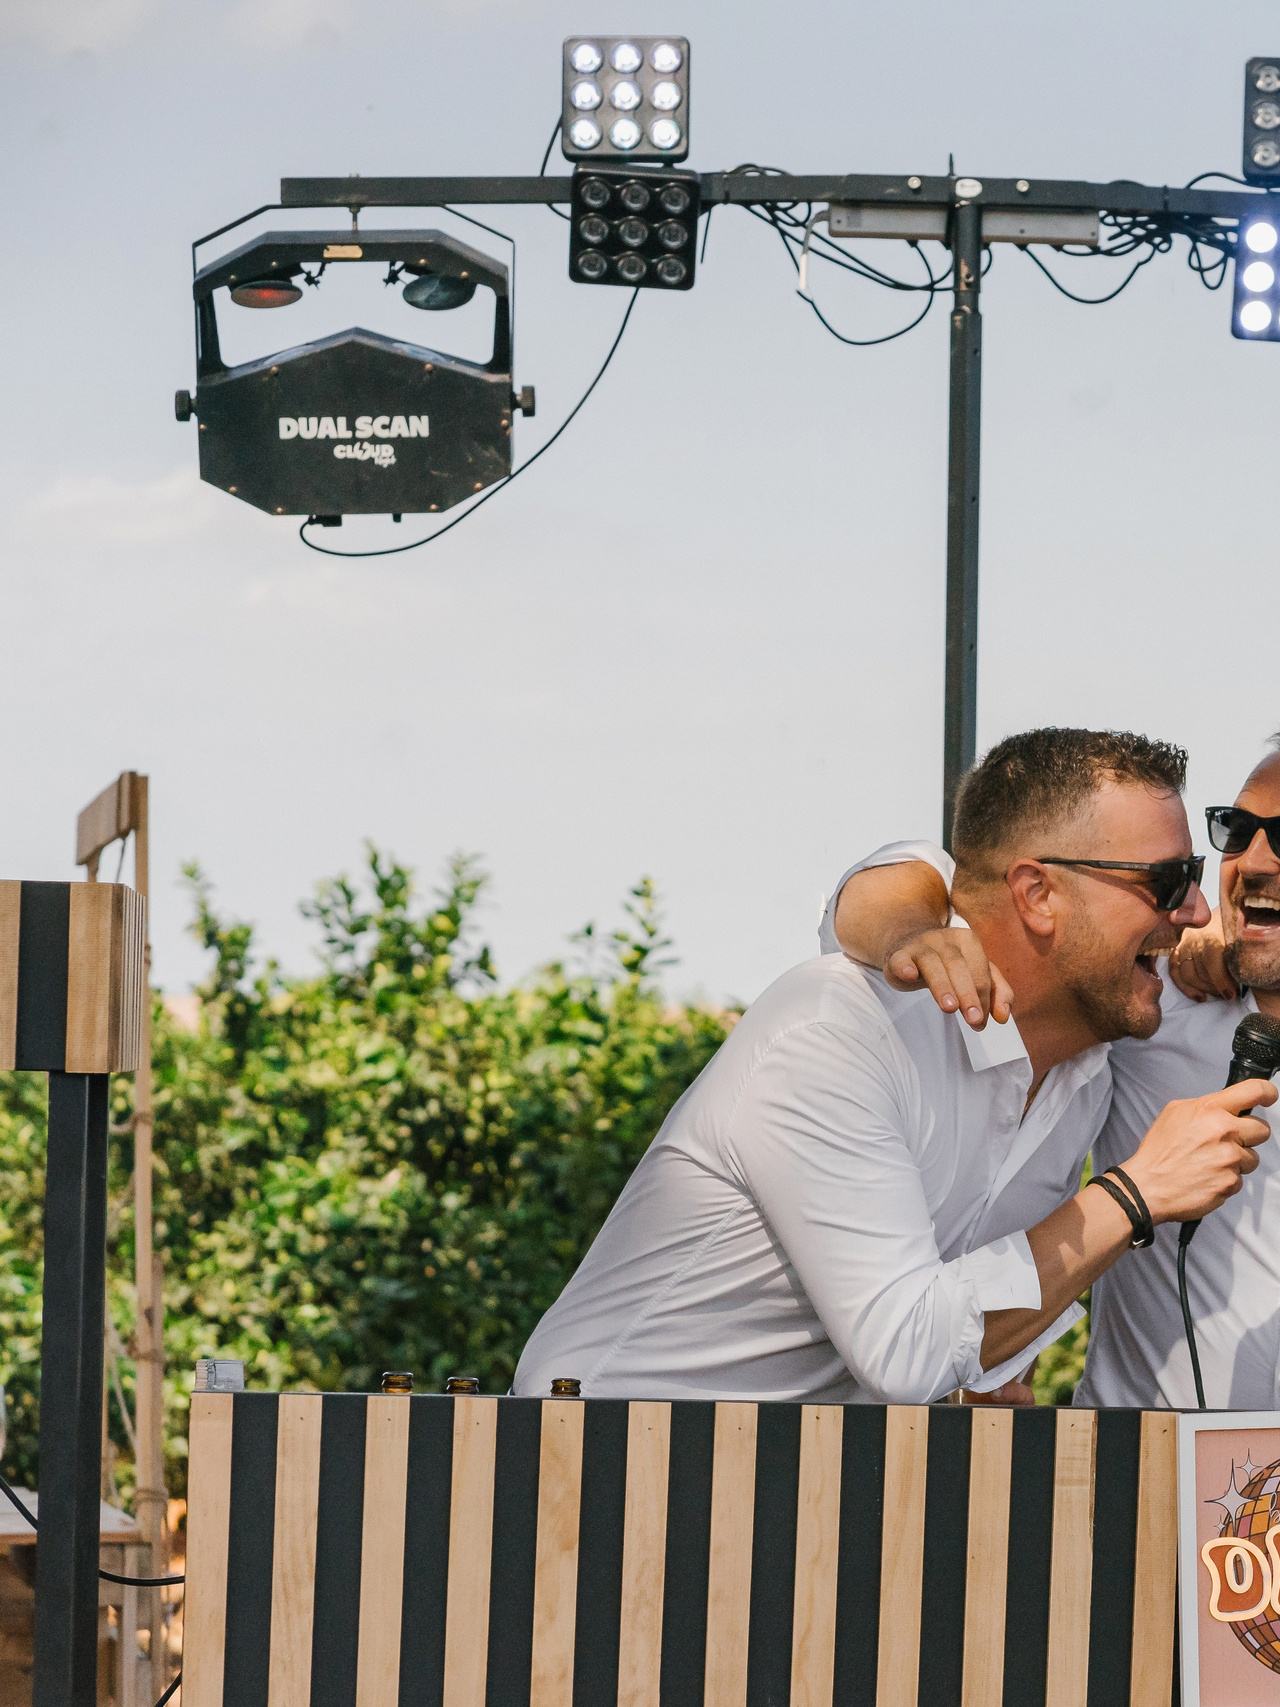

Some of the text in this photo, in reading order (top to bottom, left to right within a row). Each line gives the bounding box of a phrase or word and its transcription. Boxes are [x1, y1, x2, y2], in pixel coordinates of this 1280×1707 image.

[279, 415, 430, 440] DUAL SCAN
[333, 441, 395, 461] CLOUD
